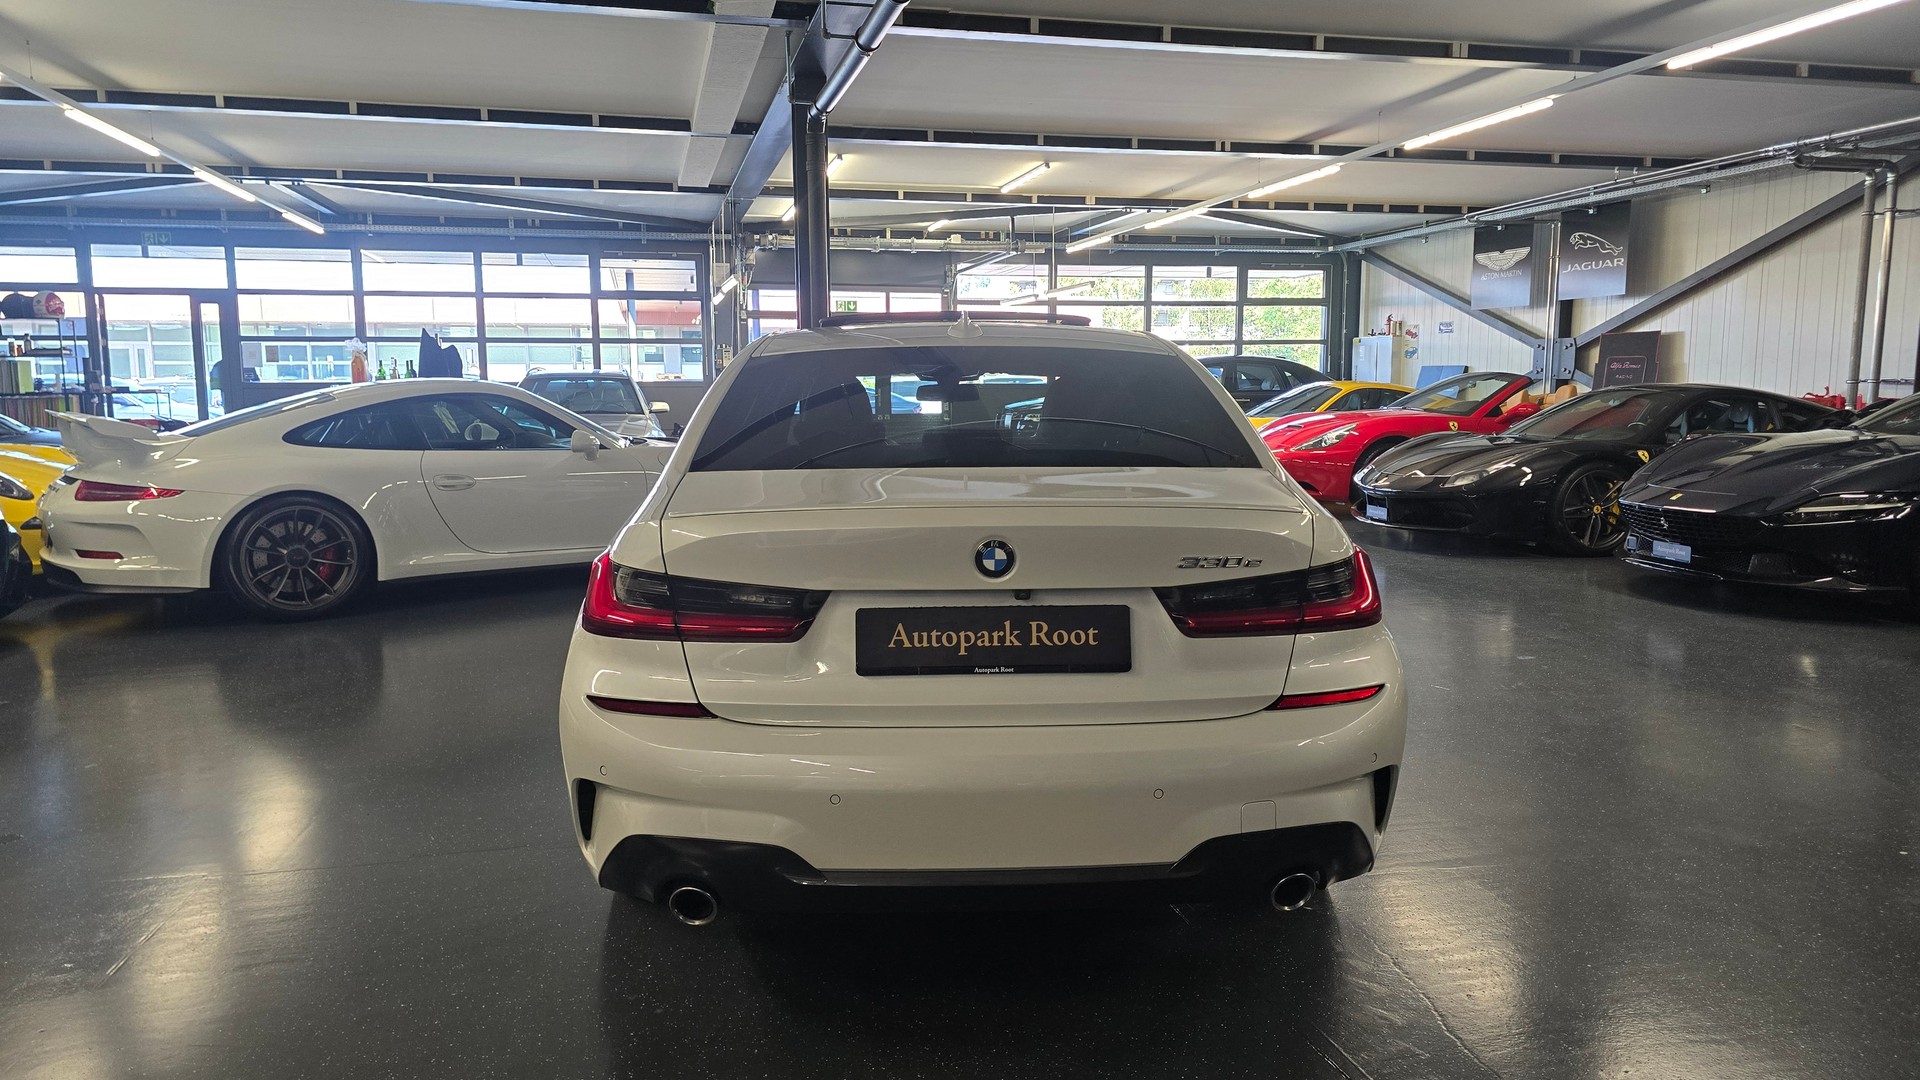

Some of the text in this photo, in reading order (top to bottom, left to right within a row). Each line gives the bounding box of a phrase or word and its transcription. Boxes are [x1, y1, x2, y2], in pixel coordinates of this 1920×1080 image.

[1562, 258, 1625, 273] JAGUAR
[1480, 269, 1522, 281] ASTON MARTIN
[1177, 556, 1263, 568] 330e
[888, 620, 1099, 656] Autopark Root
